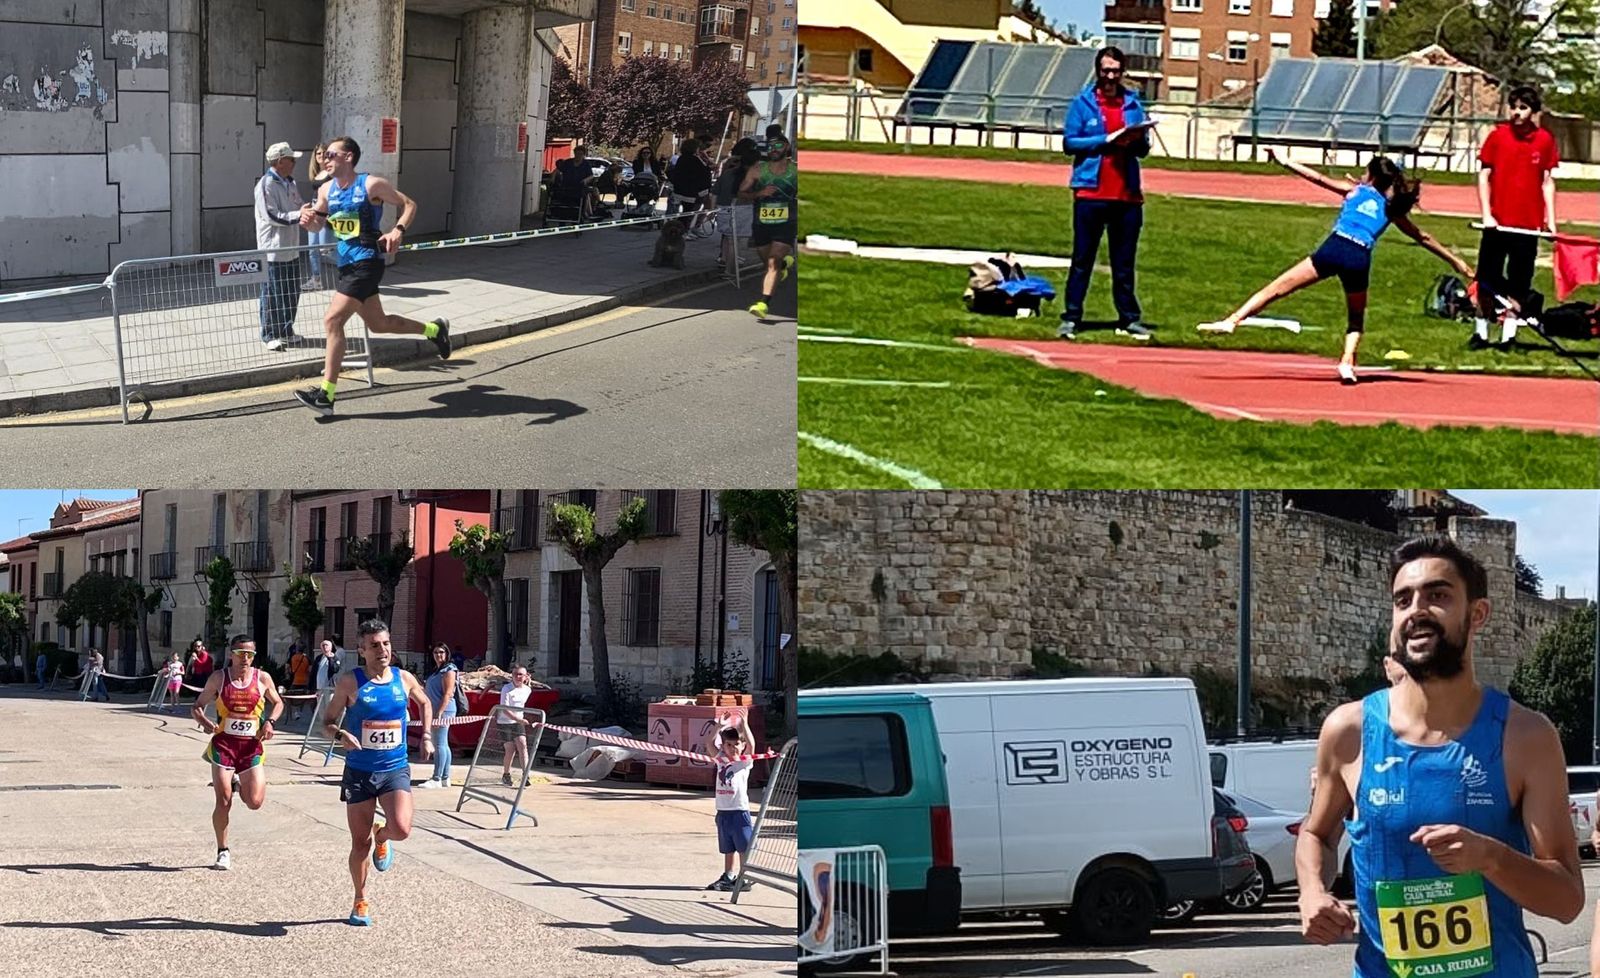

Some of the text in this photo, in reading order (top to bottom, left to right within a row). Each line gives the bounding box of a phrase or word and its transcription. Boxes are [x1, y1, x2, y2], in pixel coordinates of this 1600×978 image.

[762, 208, 784, 217] 347
[231, 721, 252, 731] 659
[369, 731, 395, 743] 611
[1071, 737, 1172, 752] OXYGENO
[1075, 751, 1171, 767] ESTRUCTURA
[1075, 768, 1085, 781] Y
[1089, 766, 1140, 781] OBRAS
[1389, 905, 1472, 951] 166
[1414, 956, 1489, 976] CAJA RURAL
